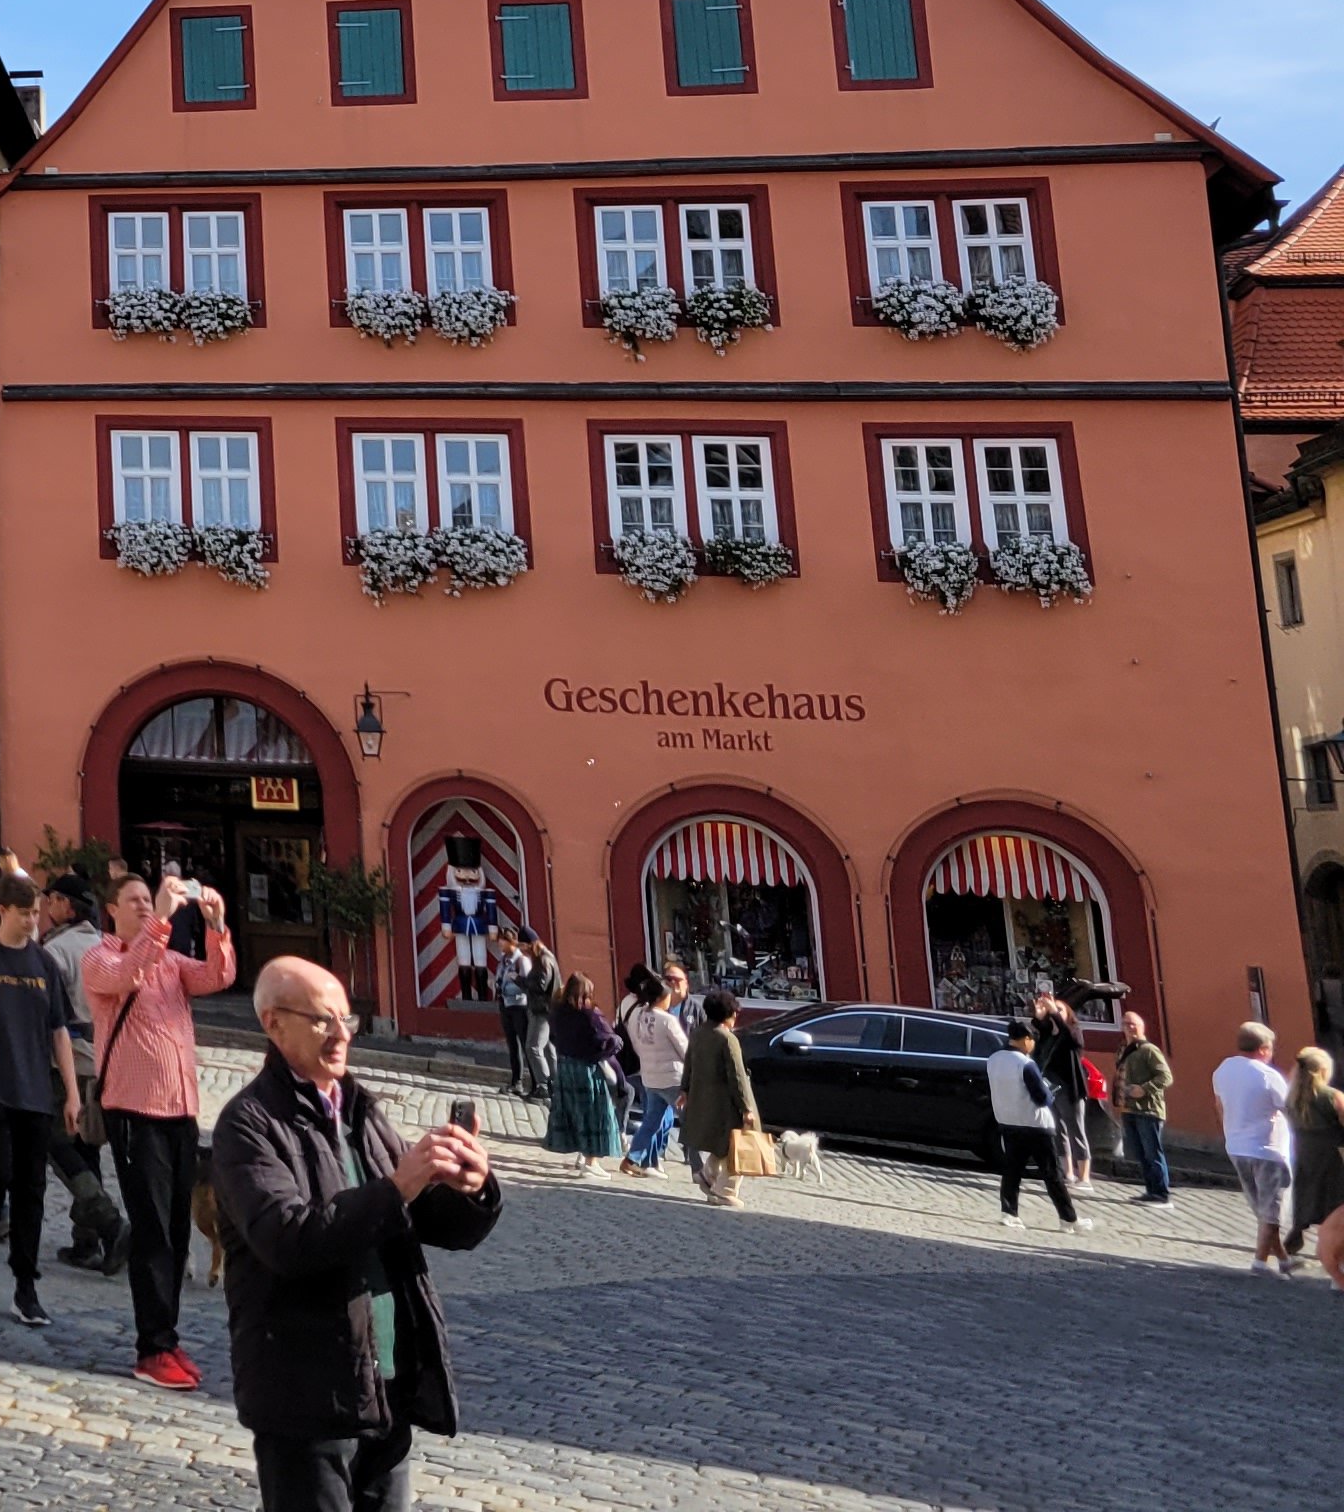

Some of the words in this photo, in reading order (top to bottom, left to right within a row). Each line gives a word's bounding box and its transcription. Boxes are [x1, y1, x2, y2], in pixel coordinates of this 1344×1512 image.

[543, 677, 867, 722] Geschenkehaus
[656, 730, 694, 750] am
[702, 728, 774, 752] Markt
